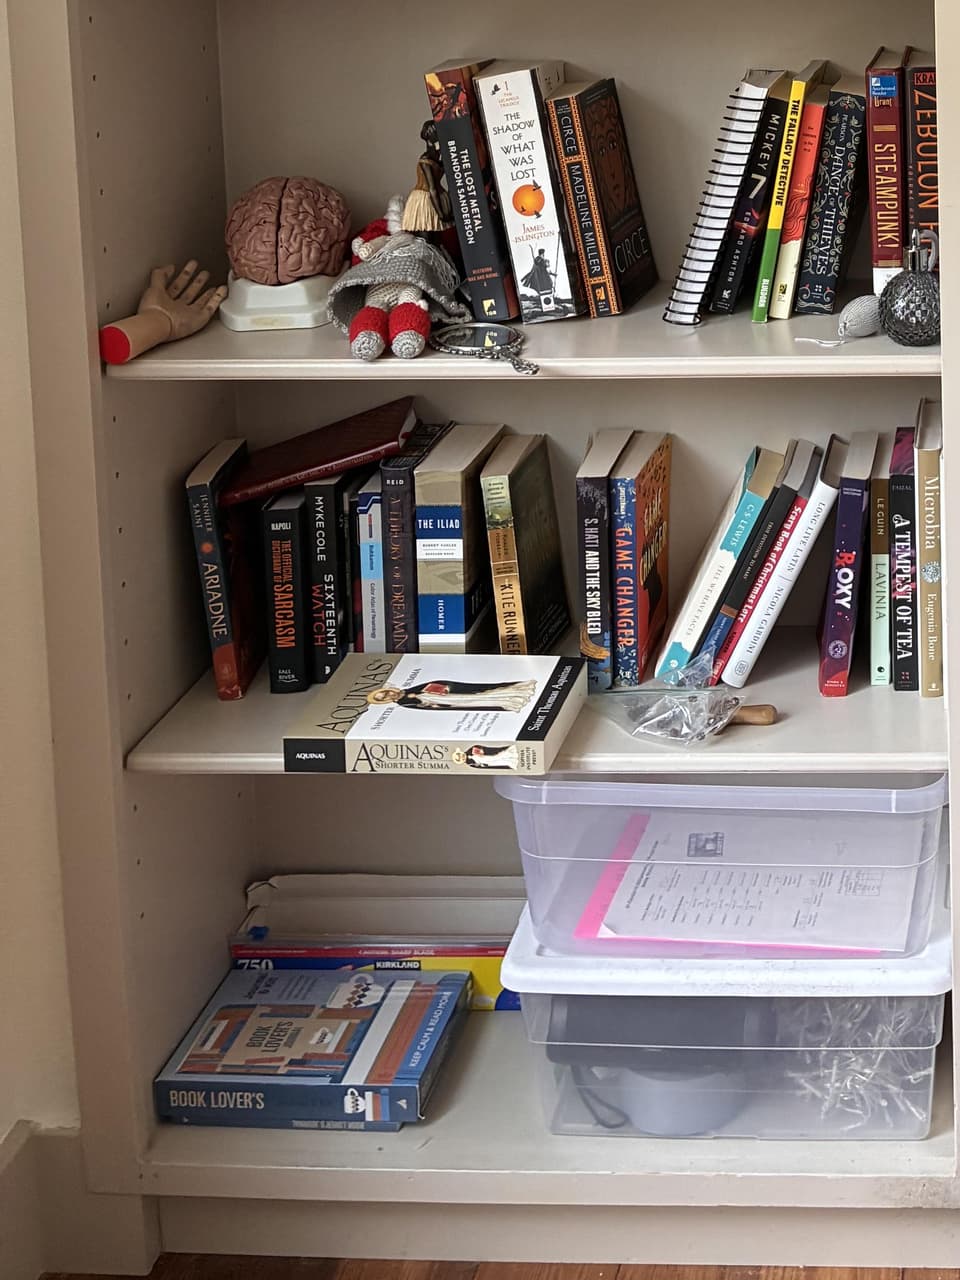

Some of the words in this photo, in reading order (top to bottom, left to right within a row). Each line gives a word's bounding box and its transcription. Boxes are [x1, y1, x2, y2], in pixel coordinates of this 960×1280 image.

[504, 112, 520, 120] THE
[791, 99, 800, 116] THE
[492, 120, 535, 134] SHADOW
[561, 116, 577, 152] CIRCE
[785, 119, 797, 155] FALLACY
[501, 142, 536, 155] WHAT
[510, 156, 533, 165] WAS
[510, 169, 536, 181] LOST
[776, 158, 791, 206] DETECTIVE
[874, 143, 900, 248] STEAMPUNK!
[418, 520, 434, 529] THE
[437, 520, 459, 529] ILIAD
[892, 514, 911, 528] A
[925, 476, 940, 549] Microbia
[616, 528, 633, 573] GAME
[894, 531, 912, 597] TEMPEST
[203, 563, 227, 638] ARIADNE
[875, 563, 886, 620] LAVINIA
[312, 584, 325, 646] WATCH
[324, 575, 336, 655] SIXTEENTH
[616, 577, 634, 647] CHANGER
[896, 600, 912, 624] OF
[897, 627, 913, 659] TEA
[376, 761, 415, 769] SHORTER
[376, 961, 419, 969] KIRKLAND
[170, 1091, 207, 1107] BOOK
[211, 1091, 264, 1108] LOVER'S
